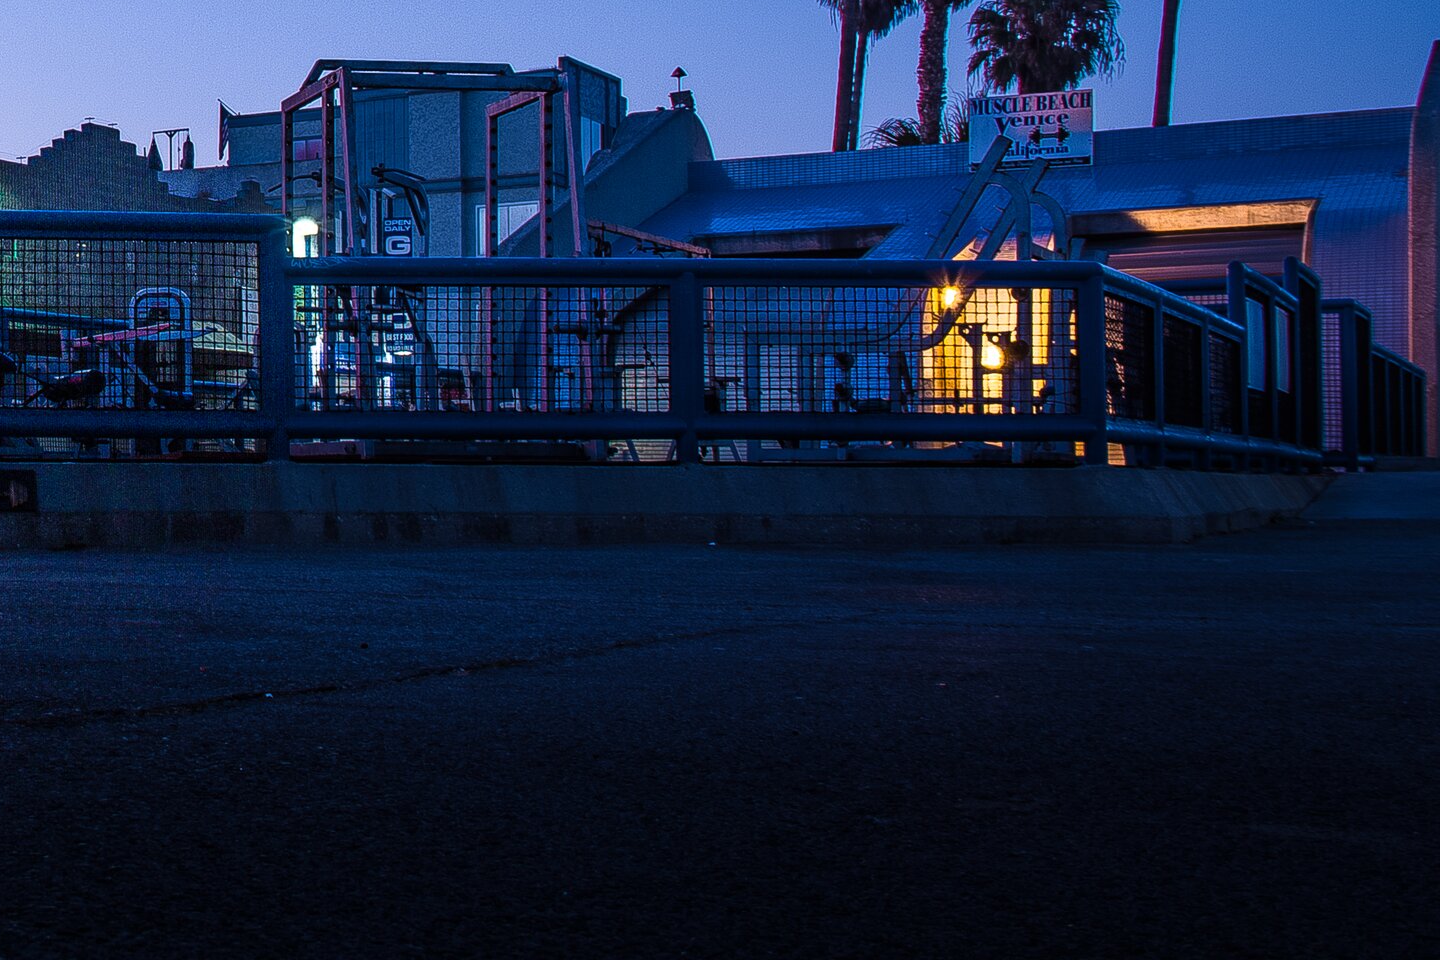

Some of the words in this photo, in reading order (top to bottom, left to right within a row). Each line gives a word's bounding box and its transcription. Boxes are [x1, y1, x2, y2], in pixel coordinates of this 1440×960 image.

[970, 98, 1033, 115] MUSCLE
[1035, 92, 1091, 111] BEACH
[994, 113, 1069, 136] Venice
[1007, 139, 1069, 159] alifornia
